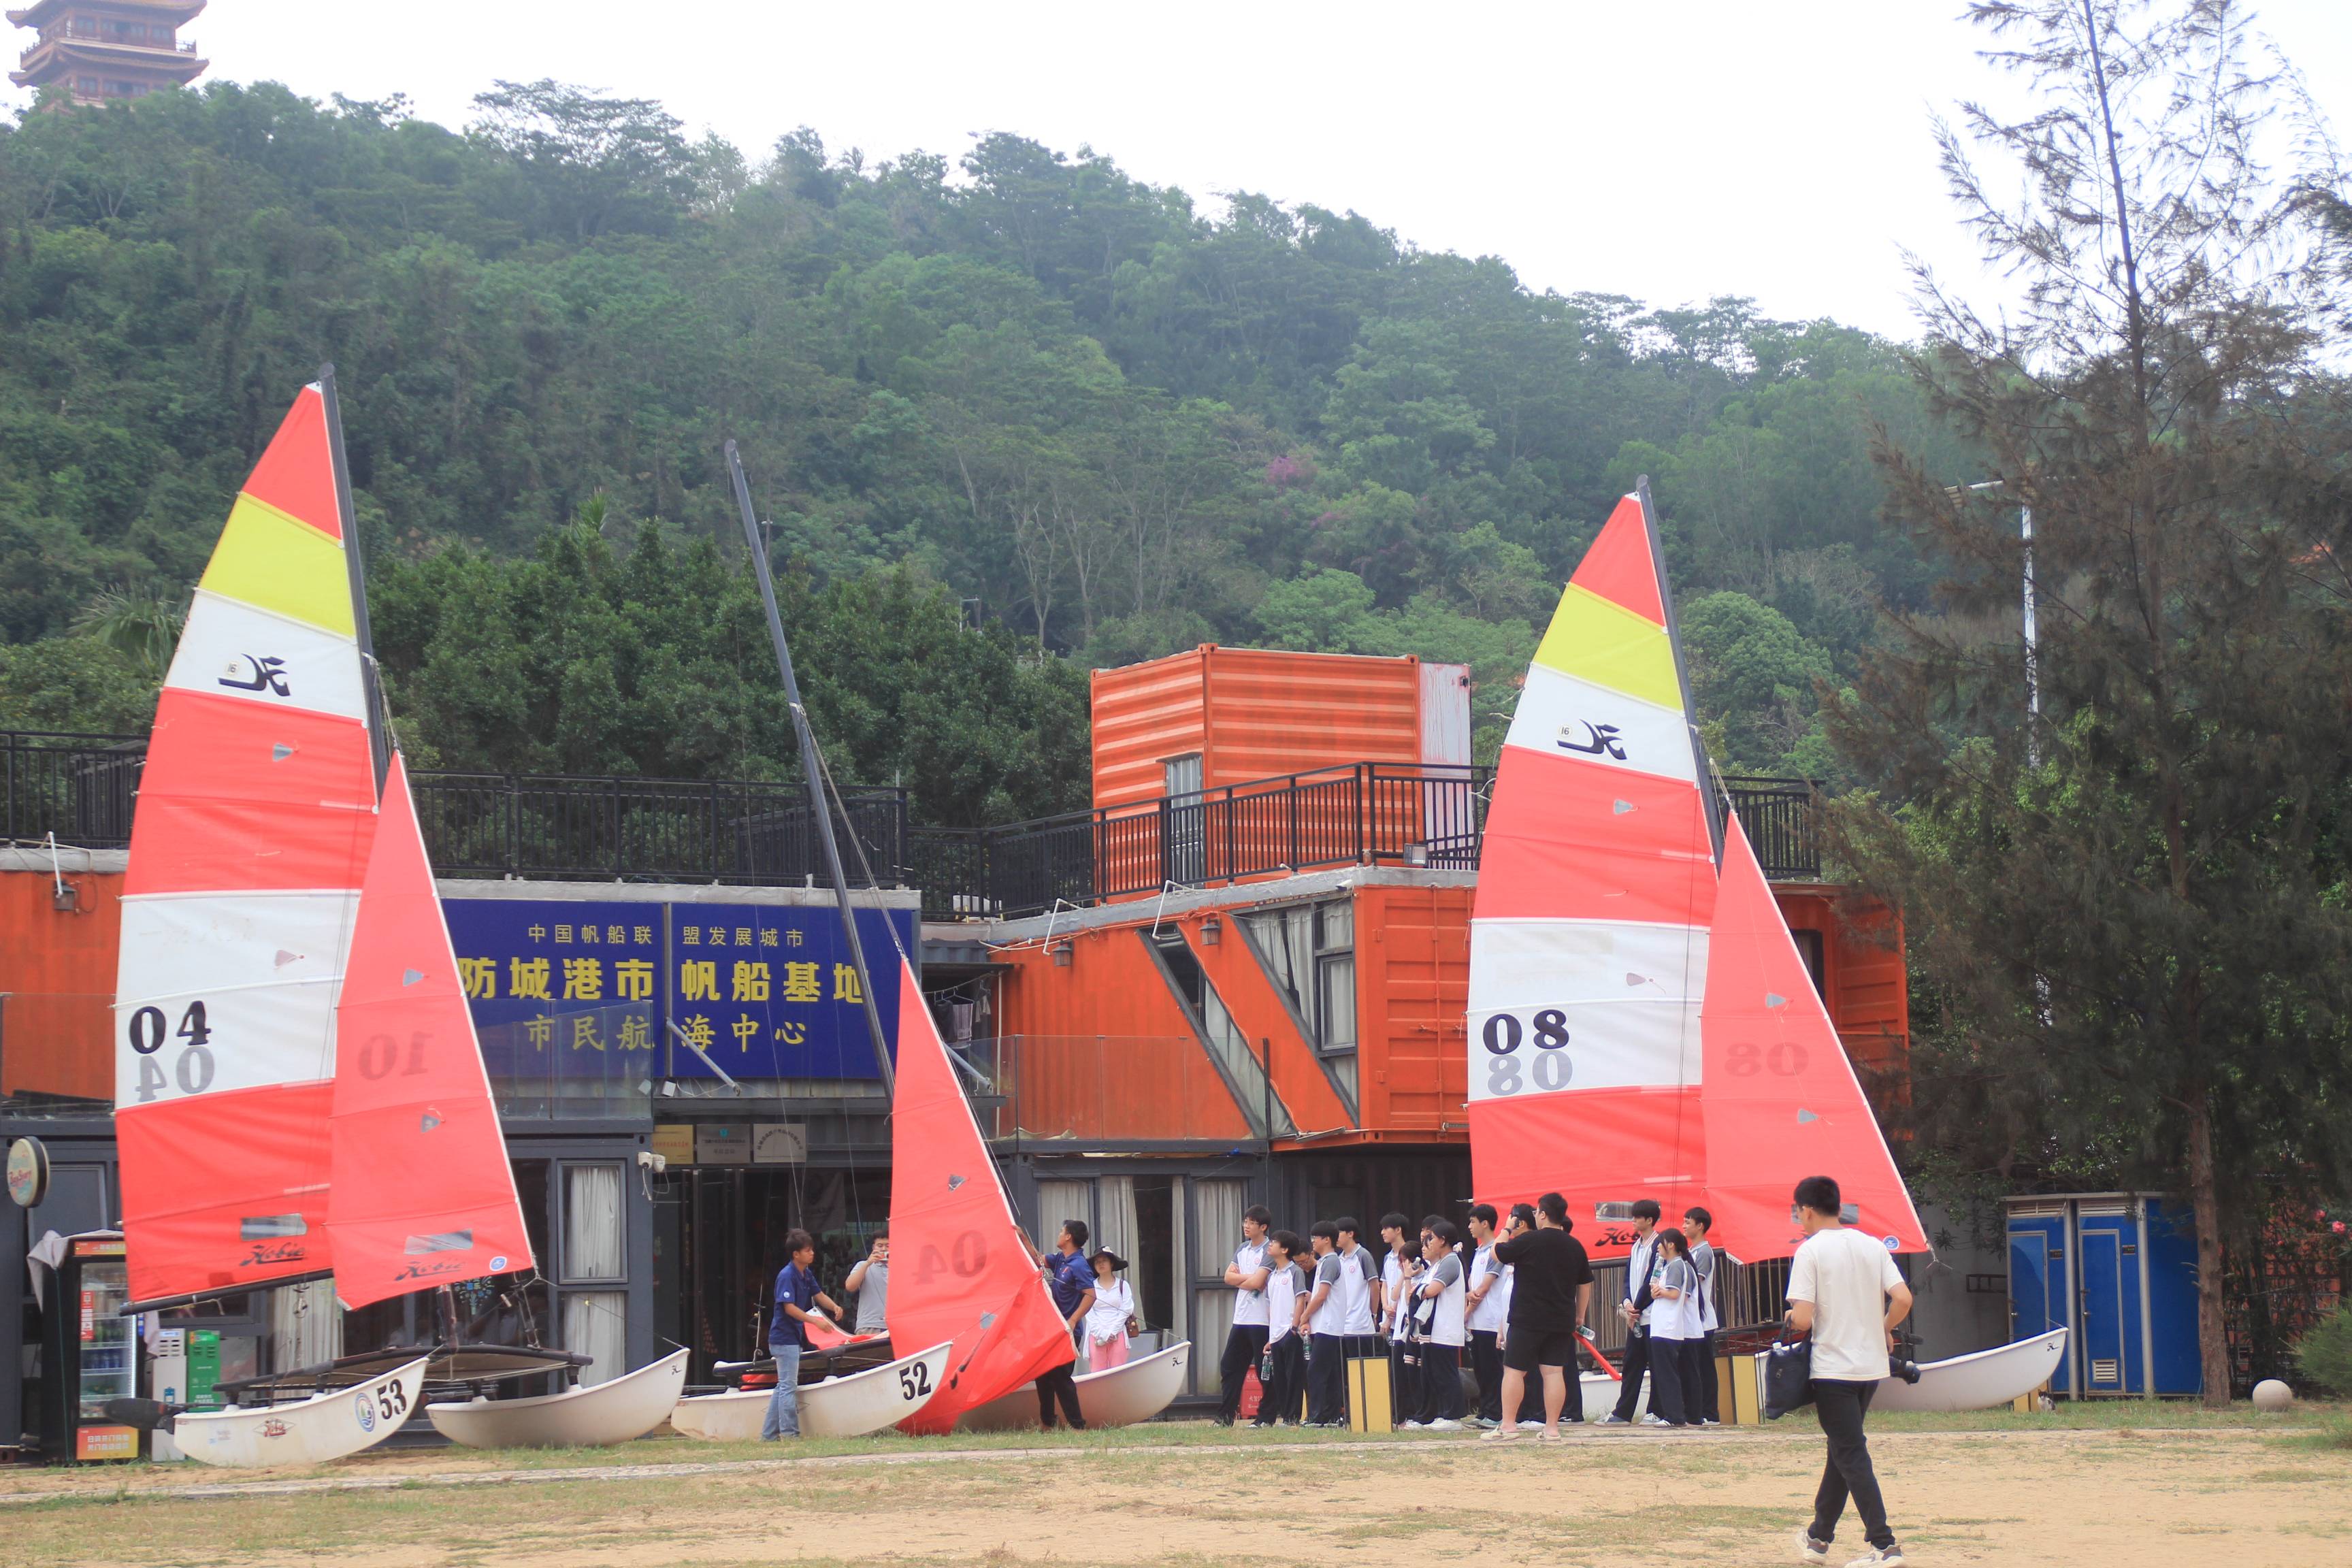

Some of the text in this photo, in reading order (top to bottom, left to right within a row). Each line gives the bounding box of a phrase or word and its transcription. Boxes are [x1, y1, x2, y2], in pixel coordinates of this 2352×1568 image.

[1561, 726, 1570, 735] 16
[528, 923, 803, 947] 中国帆船联盟发展城市
[457, 957, 868, 1004] 防城港市帆船基地
[129, 1000, 212, 1054] 04
[523, 1013, 806, 1053] 市民航海中心
[1482, 1009, 1570, 1055] 08
[240, 1241, 308, 1267] Hobie
[1595, 1227, 1641, 1247] Hob
[376, 1379, 407, 1420] 53
[899, 1361, 931, 1401] 52
